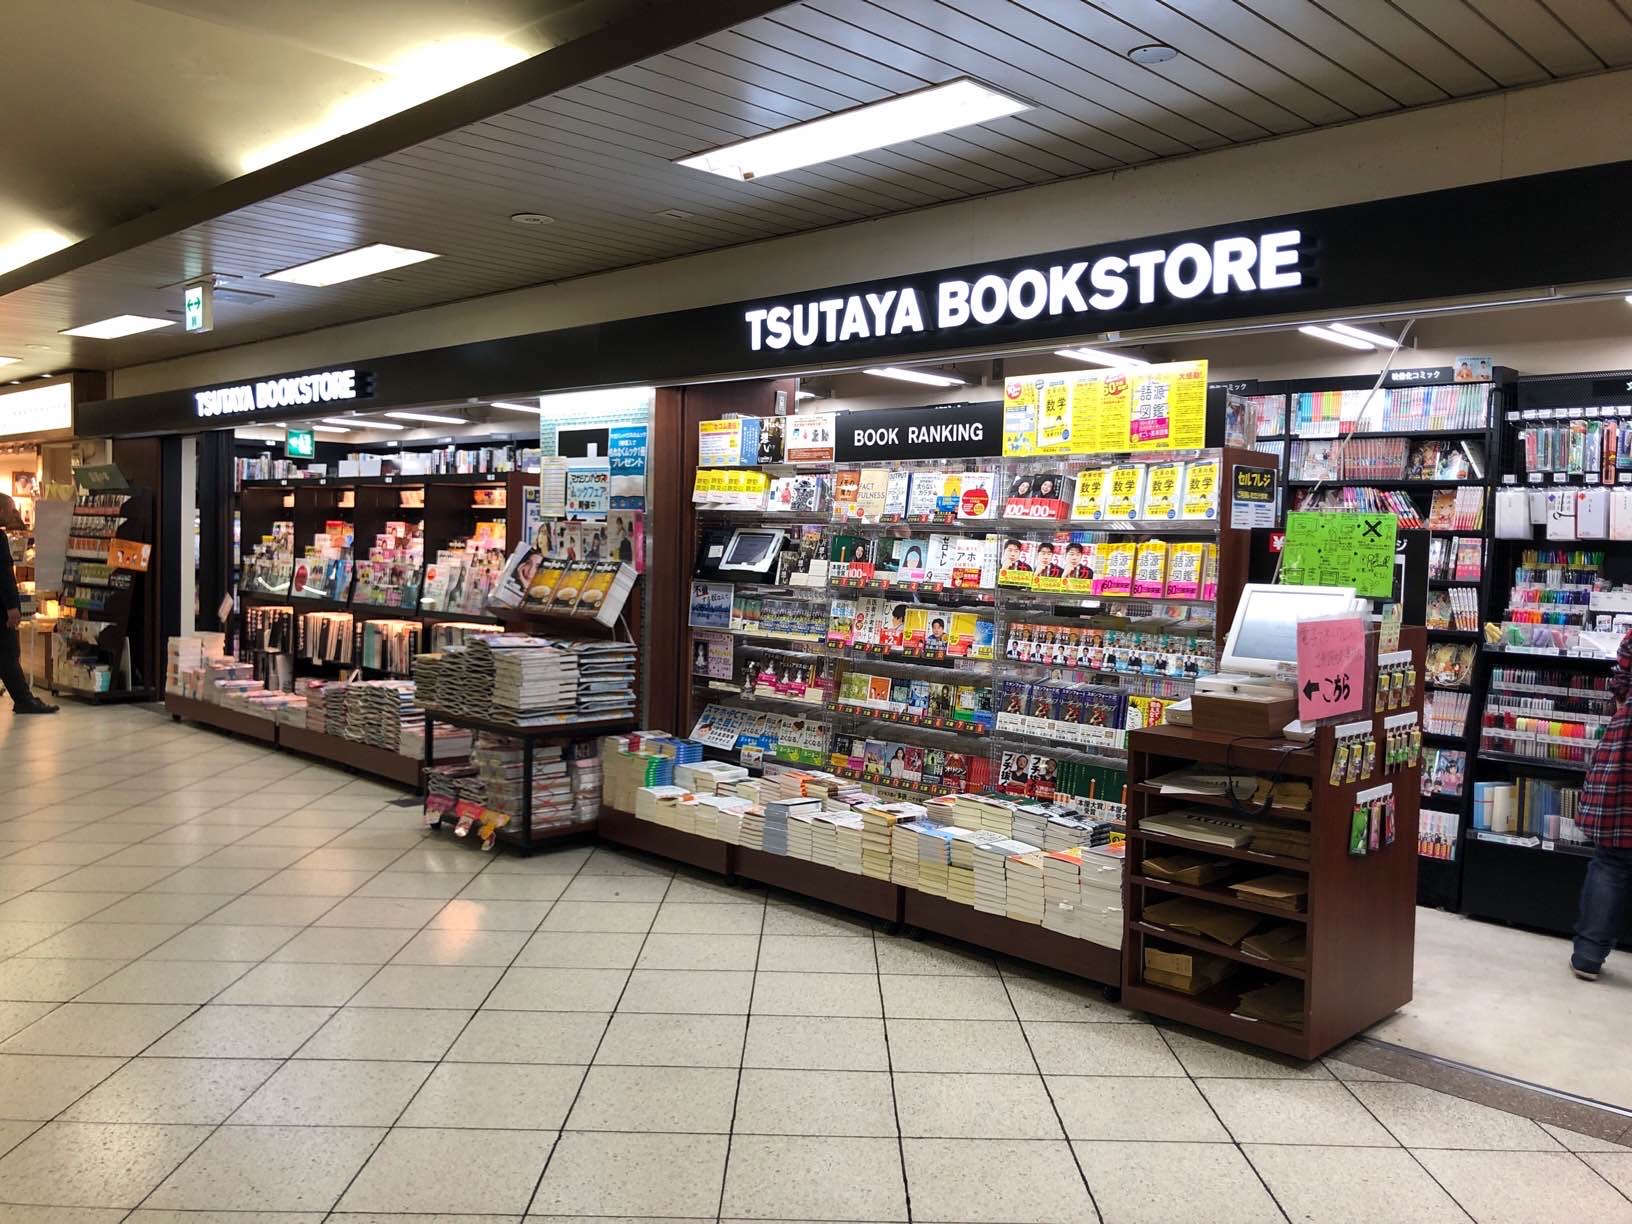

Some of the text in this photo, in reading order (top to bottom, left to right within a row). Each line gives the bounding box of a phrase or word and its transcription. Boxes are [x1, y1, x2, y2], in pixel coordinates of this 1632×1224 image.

[744, 230, 1301, 351] TSUTAYA BOOKSTORE
[195, 369, 357, 417] TSUTAYA BOOKSTORE
[1046, 397, 1067, 413] 数学
[853, 421, 984, 446] BOOK RANKING
[611, 457, 645, 468] プレゼント
[1113, 480, 1135, 493] 数学
[1152, 479, 1175, 492] 数学
[1189, 477, 1213, 490] 数学
[1237, 471, 1271, 488] セルフレジ
[1080, 481, 1101, 494] 数学
[857, 491, 887, 500] FULNESS
[939, 536, 950, 567] ゼロトレ
[957, 552, 977, 562] アホ
[1322, 673, 1351, 703] こちら
